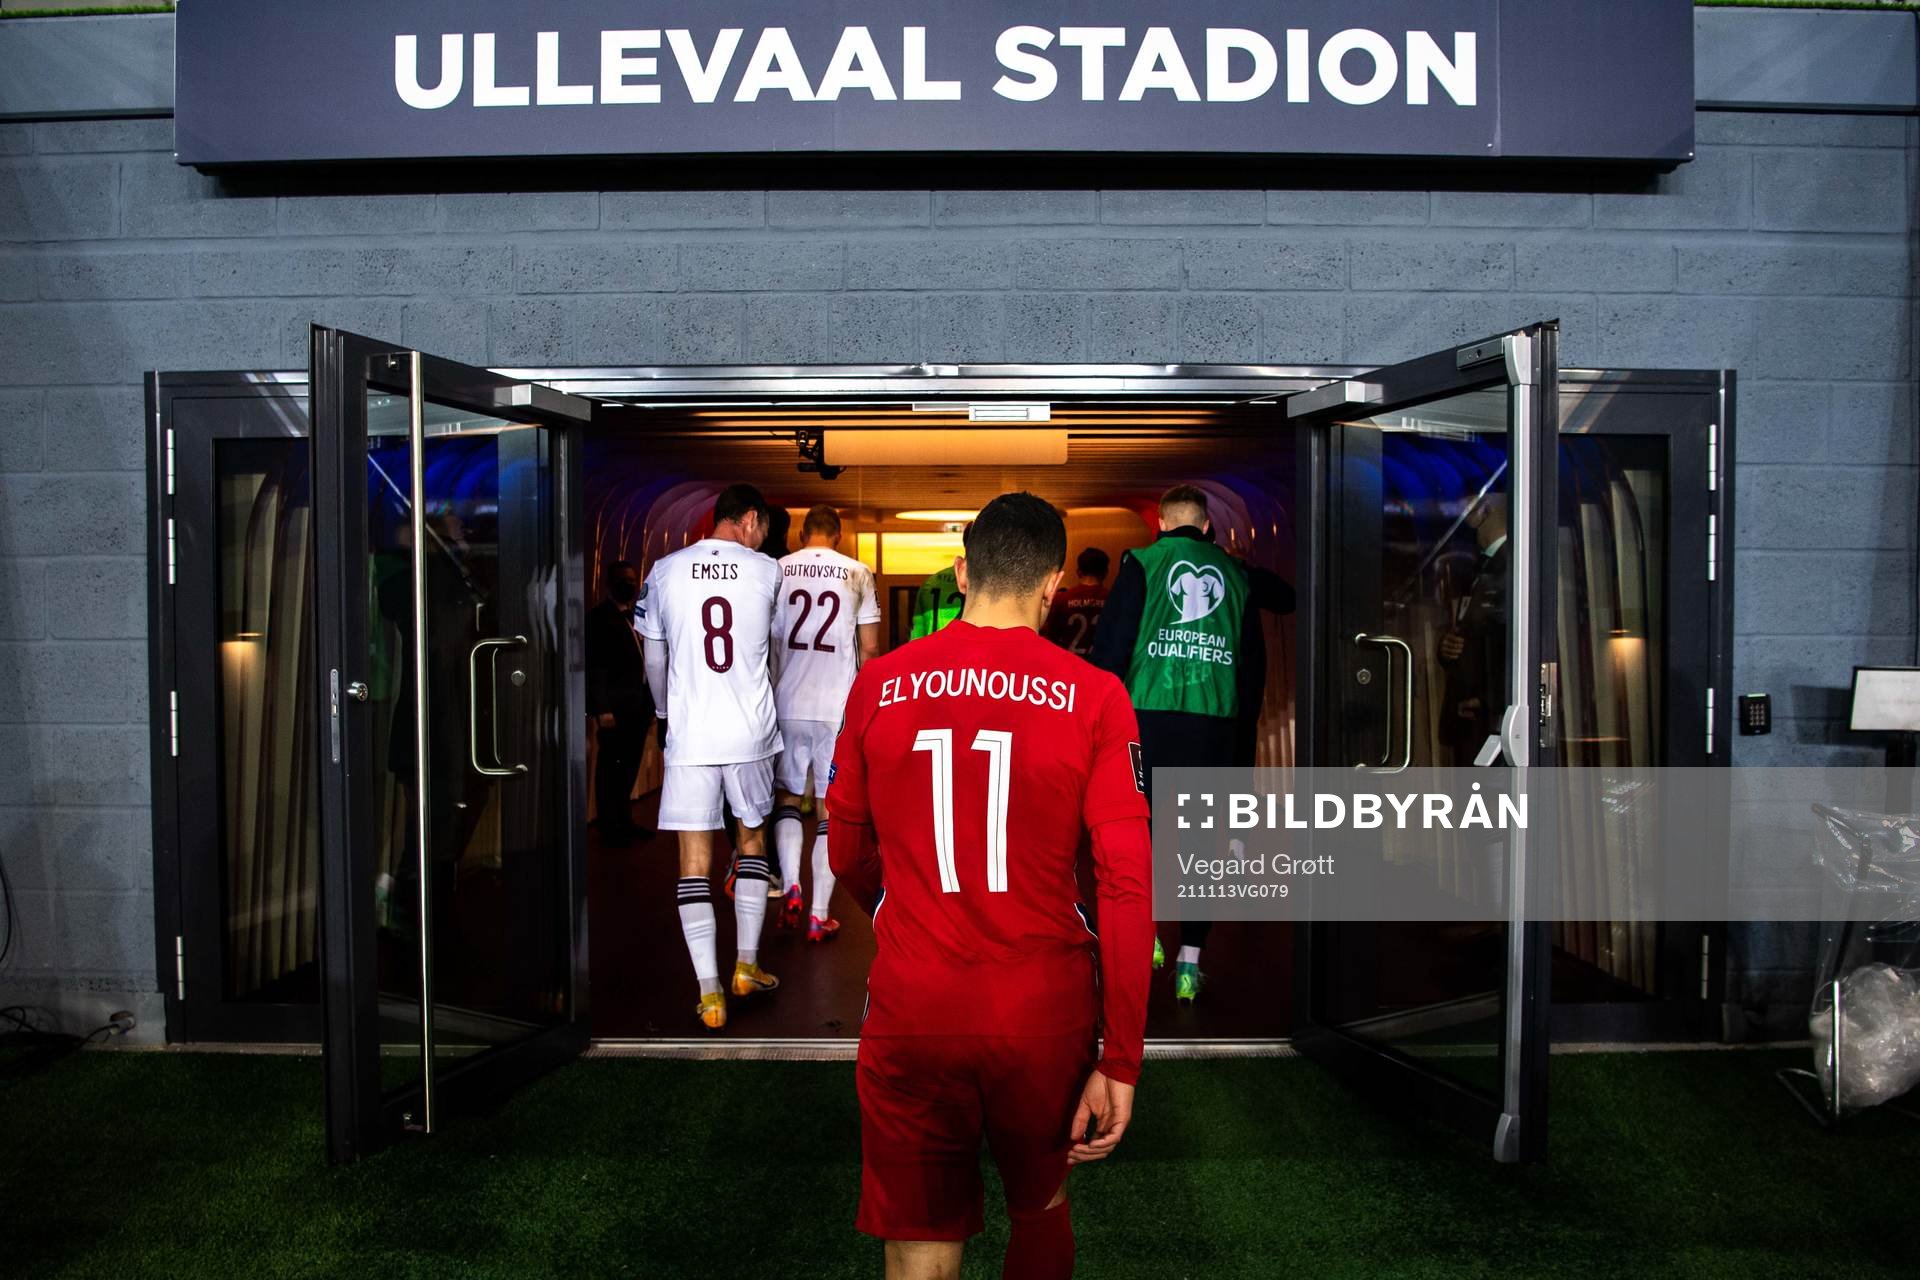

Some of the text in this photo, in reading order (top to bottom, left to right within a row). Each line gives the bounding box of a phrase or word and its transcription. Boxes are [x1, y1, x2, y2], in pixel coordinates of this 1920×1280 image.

[394, 26, 1477, 109] ULLEVAAL STADION
[692, 563, 739, 580] EMSIS
[784, 564, 849, 581] GUTKOVSKIS
[701, 596, 734, 674] 8
[788, 588, 841, 653] 22
[1158, 628, 1226, 648] EUROPEAN
[1147, 641, 1233, 666] QUALIFIERS
[878, 668, 1076, 713] ELYOUNOUSSI
[912, 728, 1013, 894] 11
